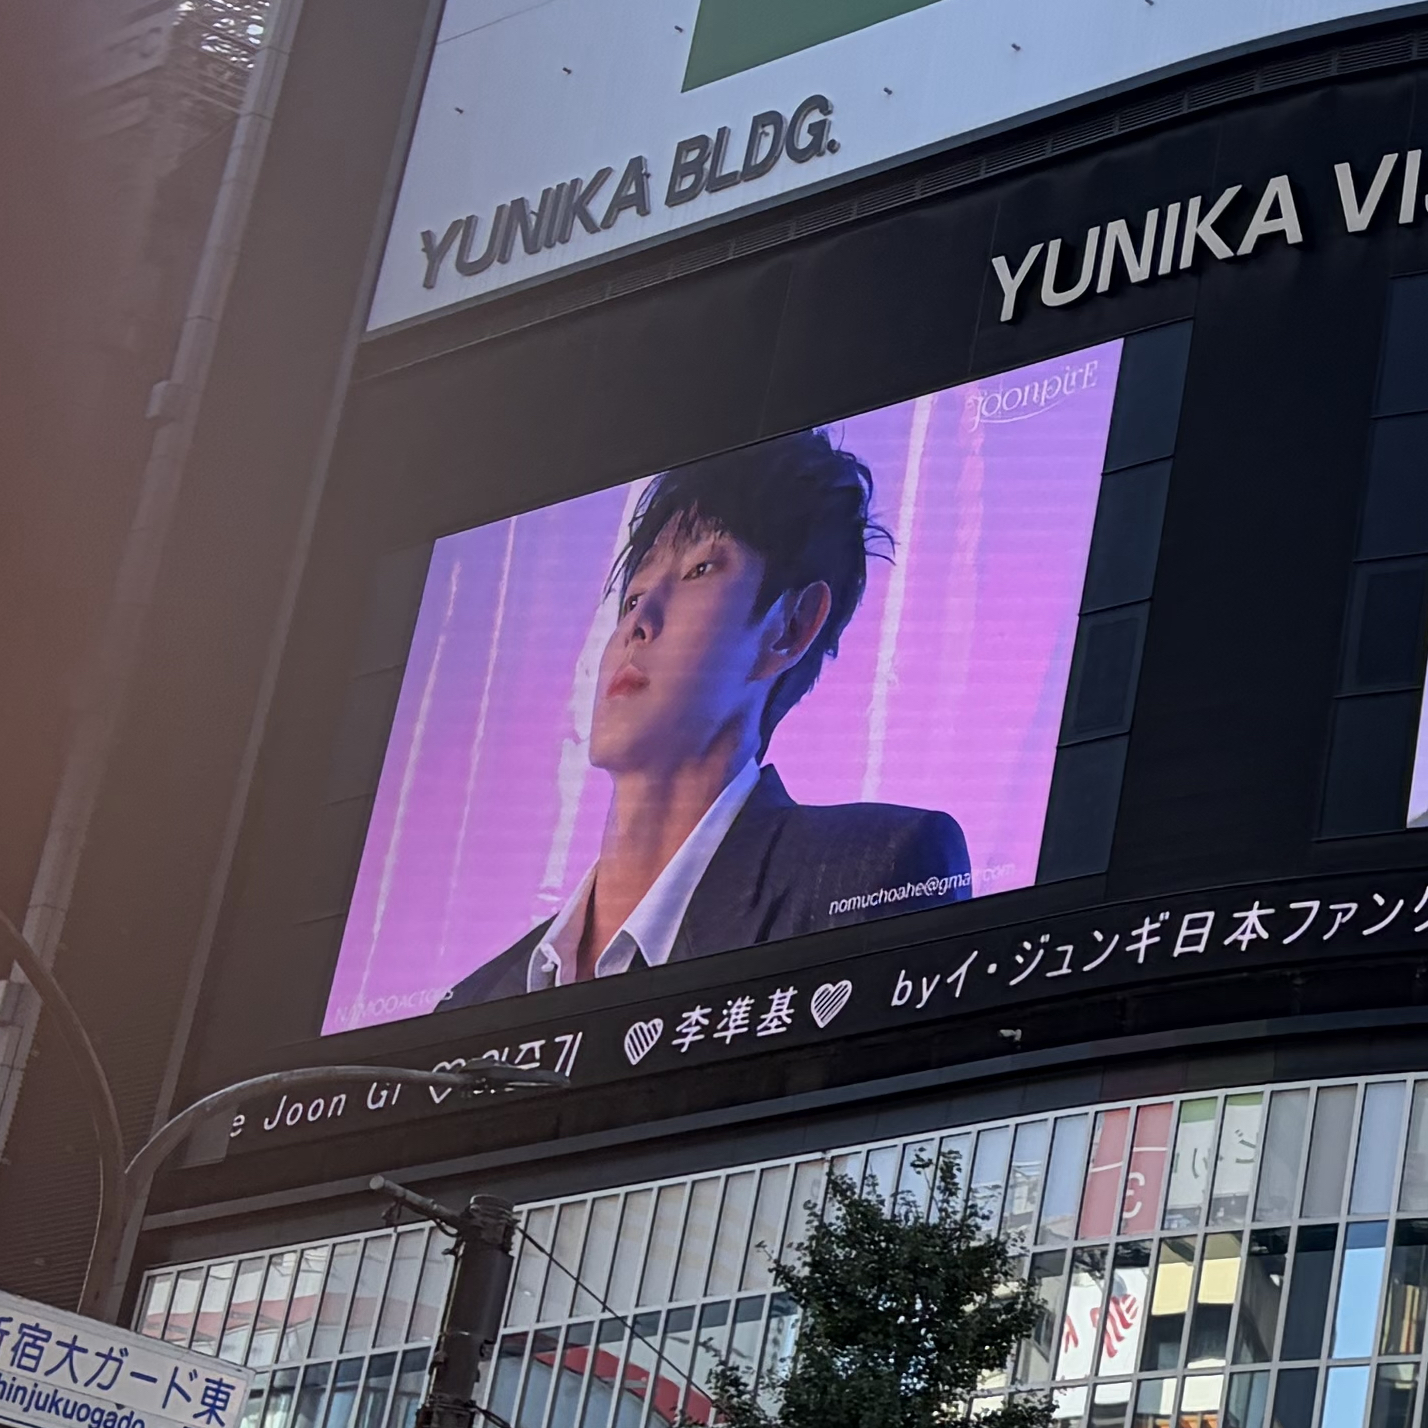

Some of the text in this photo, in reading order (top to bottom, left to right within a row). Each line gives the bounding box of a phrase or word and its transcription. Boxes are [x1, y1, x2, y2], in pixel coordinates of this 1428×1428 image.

[420, 93, 841, 289] YUNIKA BLDG.
[991, 174, 1304, 323] YUNIKA
[262, 1092, 347, 1132] Joon
[670, 985, 798, 1054] 李準基
